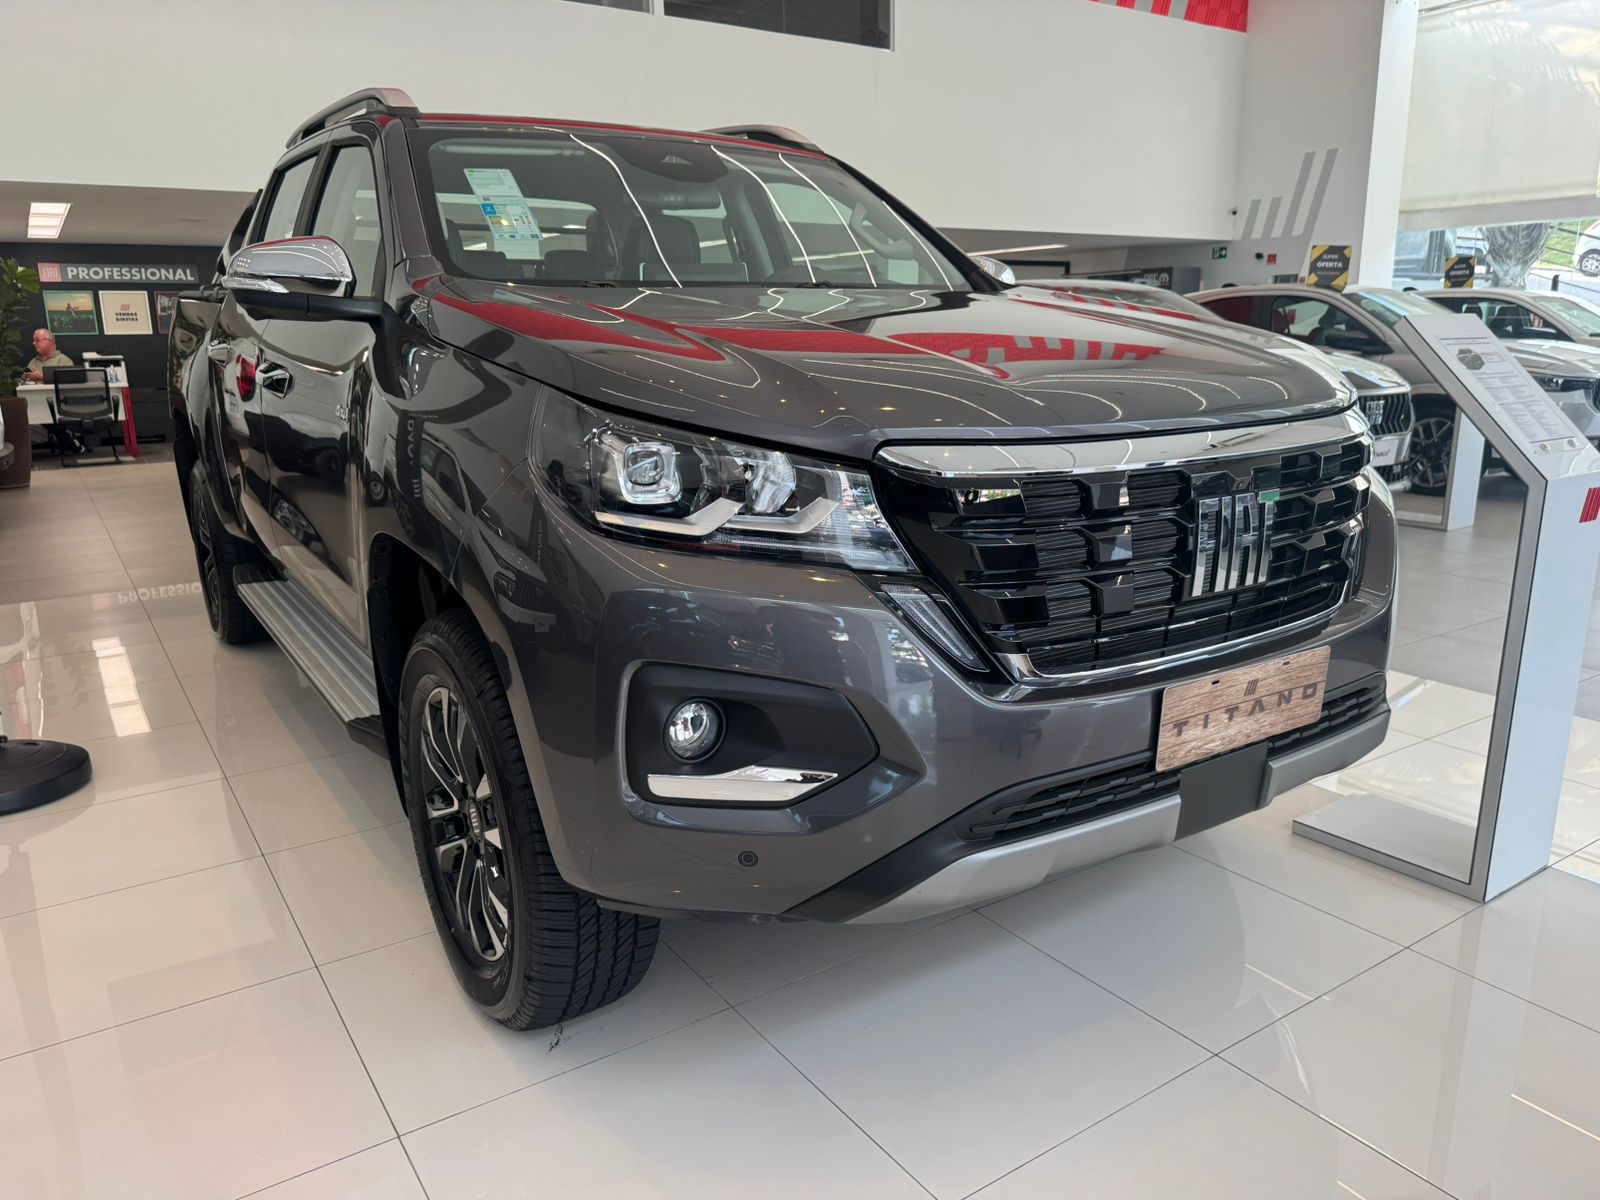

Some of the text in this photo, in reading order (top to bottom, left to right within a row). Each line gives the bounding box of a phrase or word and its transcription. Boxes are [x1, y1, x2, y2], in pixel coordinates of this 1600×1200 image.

[67, 266, 195, 281] PROFESSIONAL
[1192, 488, 1280, 597] FIAT
[1173, 683, 1319, 737] TITANO
